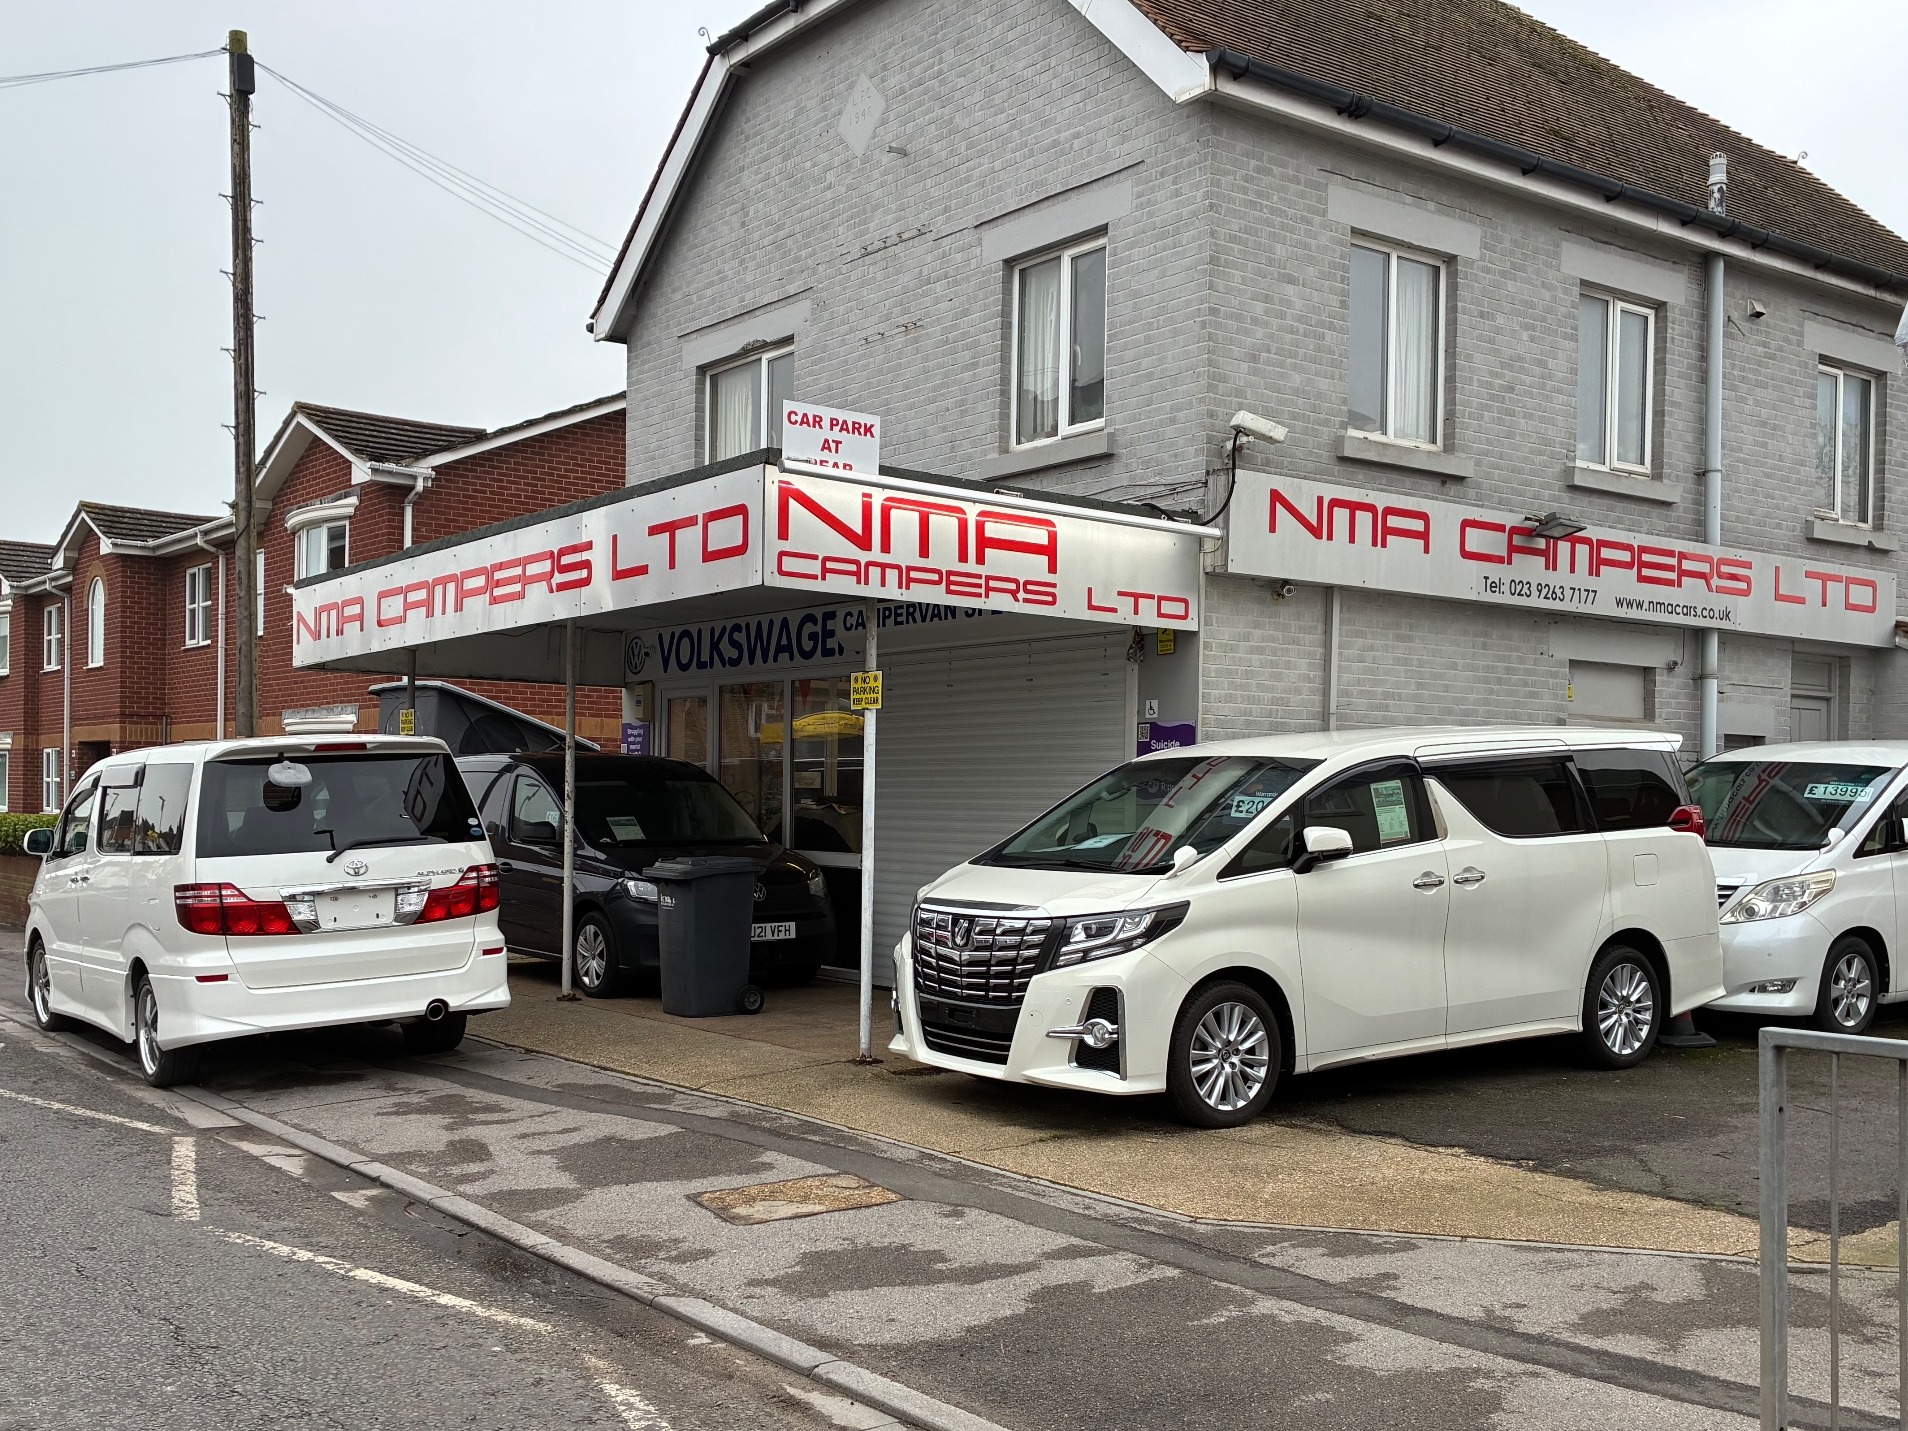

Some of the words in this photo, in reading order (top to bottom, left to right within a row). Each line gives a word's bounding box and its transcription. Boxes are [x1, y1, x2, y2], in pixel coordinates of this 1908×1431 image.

[787, 410, 823, 430] CAR
[829, 417, 875, 438] PARK
[820, 438, 843, 454] AT
[777, 480, 1057, 574] NMA
[1268, 488, 1430, 554] NMA
[1460, 518, 1752, 597] CAMPERS
[1775, 566, 1878, 614] LTD
[296, 595, 365, 645] NMA
[376, 540, 593, 628] CAMPERS
[611, 503, 749, 582] LTD
[777, 549, 1057, 607] CAMPERS
[1087, 586, 1190, 620] LTD
[1483, 576, 1505, 595] Tel:
[1509, 579, 1532, 597] 023
[1536, 583, 1565, 603] 9263
[1569, 587, 1598, 606] 7177
[1615, 596, 1732, 622] www.nmacars.co.uk
[658, 611, 860, 674] VOLKSWAGE
[853, 686, 879, 696] PARKING
[861, 676, 870, 685] NO
[1151, 740, 1180, 750] Suicide
[770, 925, 791, 938] VFH
